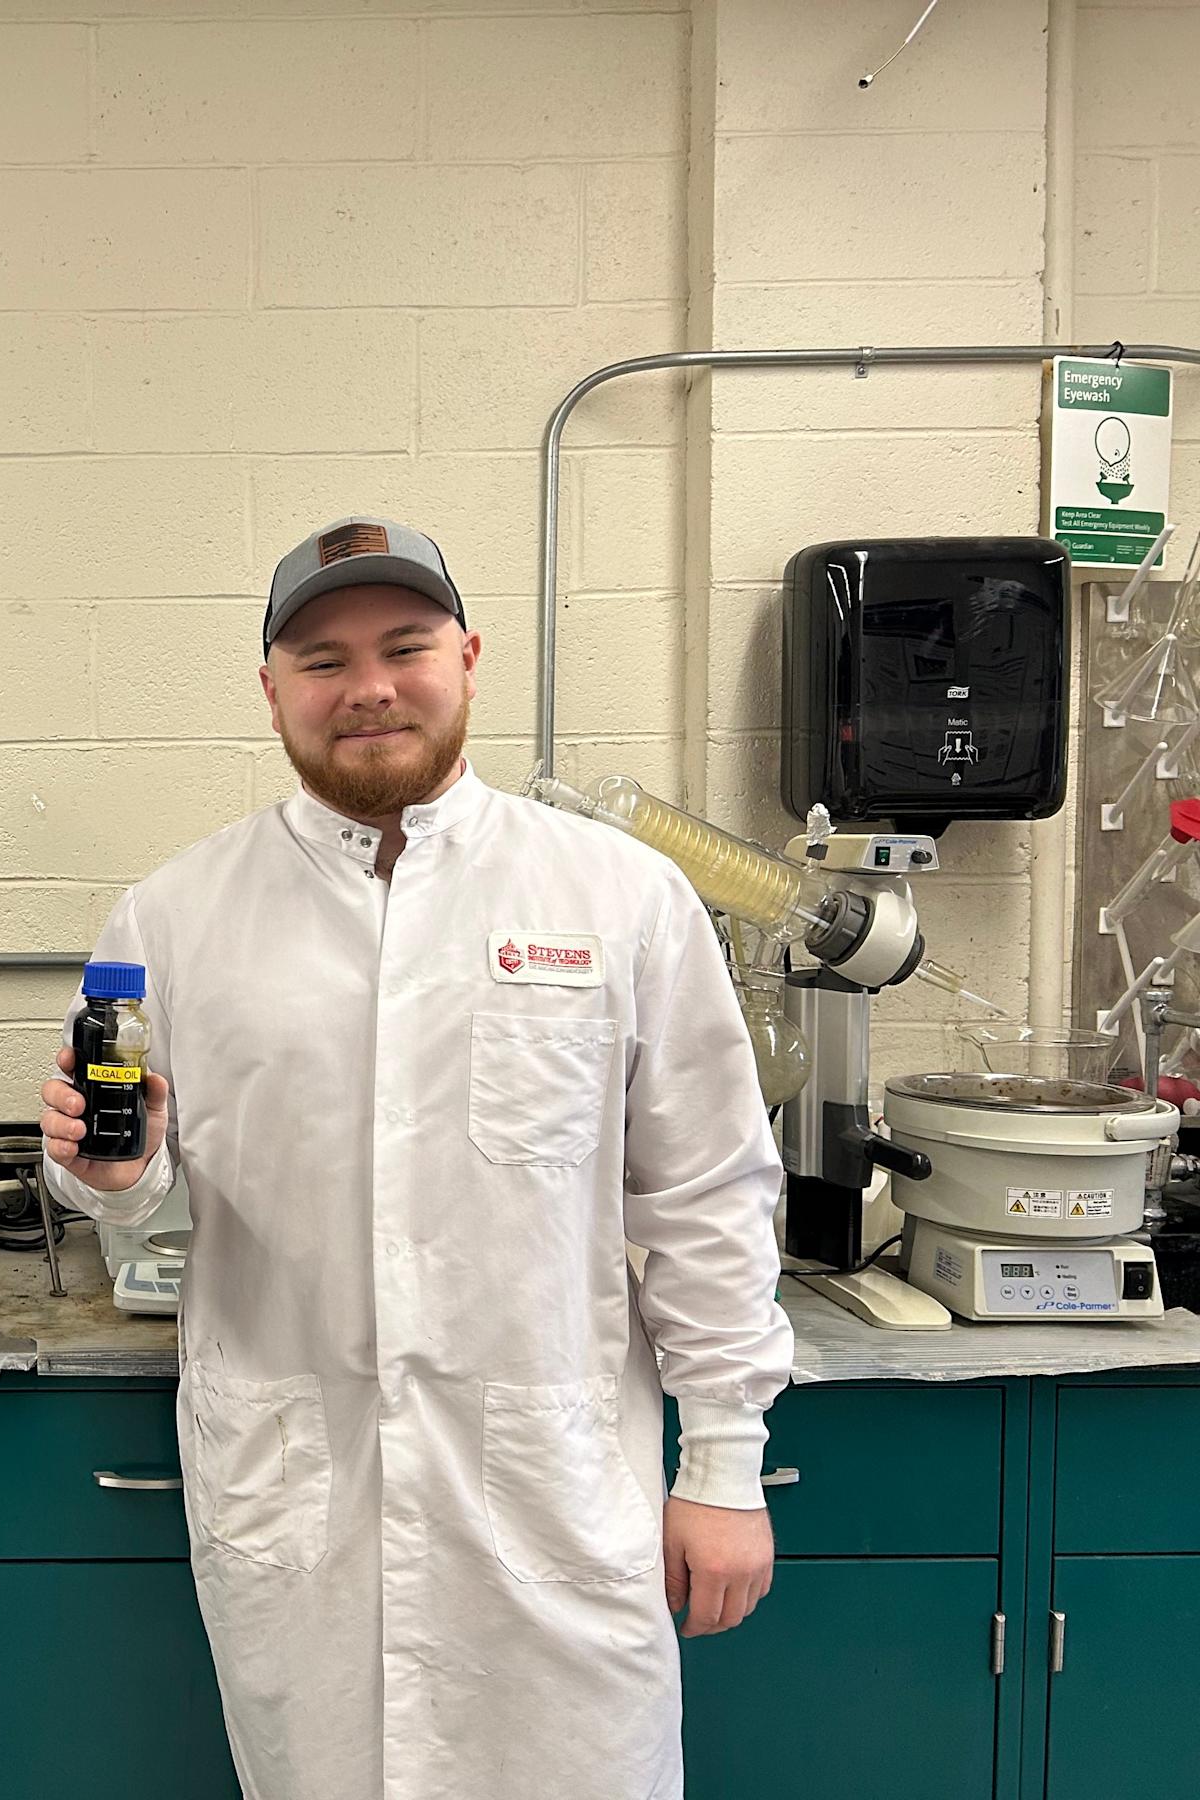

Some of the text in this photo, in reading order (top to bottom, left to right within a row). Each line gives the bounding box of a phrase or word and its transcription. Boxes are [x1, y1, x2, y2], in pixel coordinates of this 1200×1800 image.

[1064, 370, 1123, 390] Emergency
[1064, 388, 1110, 403] Eyewash
[1081, 521, 1108, 529] Emergency
[1109, 522, 1134, 530] Equipment
[1072, 542, 1094, 550] Guardian
[948, 690, 968, 698] TORK
[948, 718, 968, 726] Matic
[528, 944, 591, 959] STEVENS
[90, 1068, 138, 1079] ALGAL OIL
[1056, 1302, 1111, 1310] Cole-Parmer
